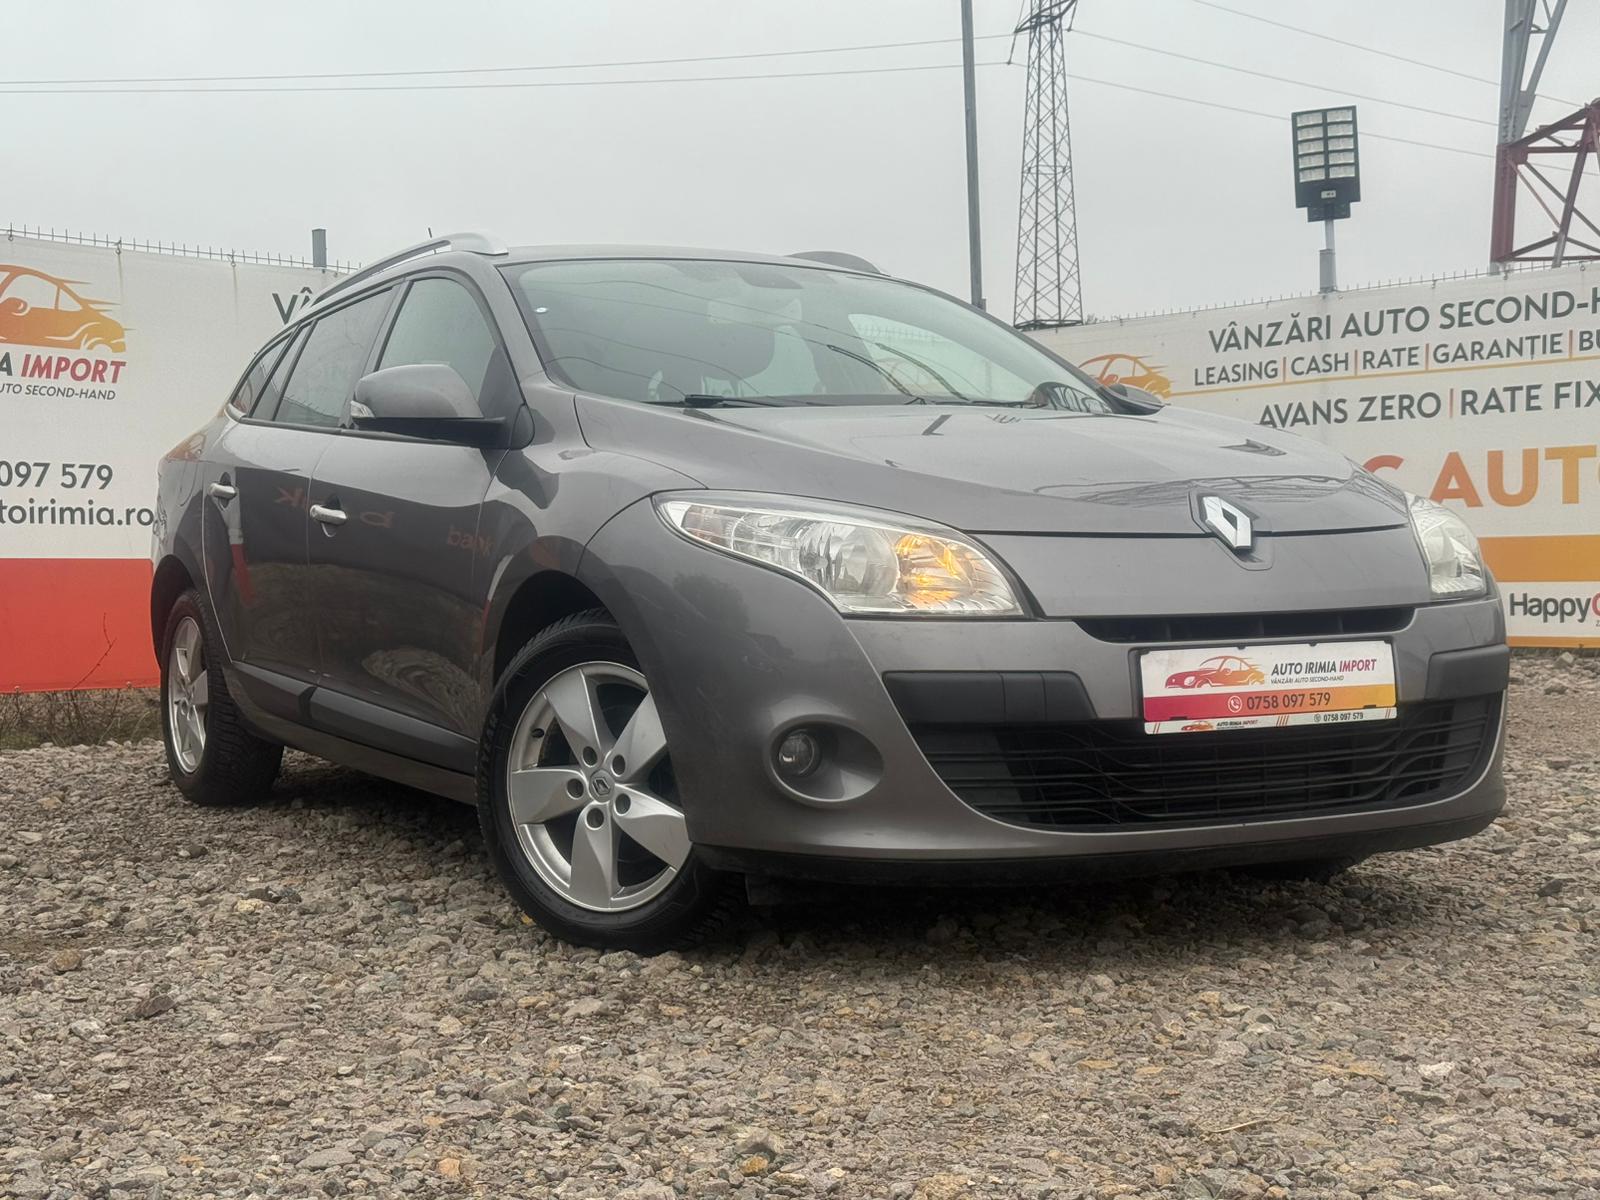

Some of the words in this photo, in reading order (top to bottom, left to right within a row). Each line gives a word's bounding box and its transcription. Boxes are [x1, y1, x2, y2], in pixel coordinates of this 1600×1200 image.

[1209, 312, 1331, 353] VÂNZĂRI
[1341, 306, 1430, 338] AUTO
[21, 354, 127, 384] IMPORT
[1195, 360, 1278, 386] LEASING
[1291, 352, 1349, 376] CASH
[1363, 346, 1420, 370] RATE
[1433, 333, 1563, 364] GARANȚIE
[25, 385, 116, 400] SECOND-HAND
[1260, 398, 1348, 428] AVANS
[1357, 392, 1441, 422] ZERO
[1461, 384, 1543, 416] RATE
[0, 461, 50, 487] 097
[61, 463, 113, 490] 579
[1429, 445, 1600, 508] AUT
[1271, 662, 1303, 676] AUTO
[1305, 661, 1337, 675] IRIMIA
[1339, 659, 1377, 673] IMPORT
[1247, 695, 1279, 710] 0758
[1283, 693, 1306, 708] 097
[1309, 692, 1331, 706] 579
[1323, 713, 1339, 722] 0758
